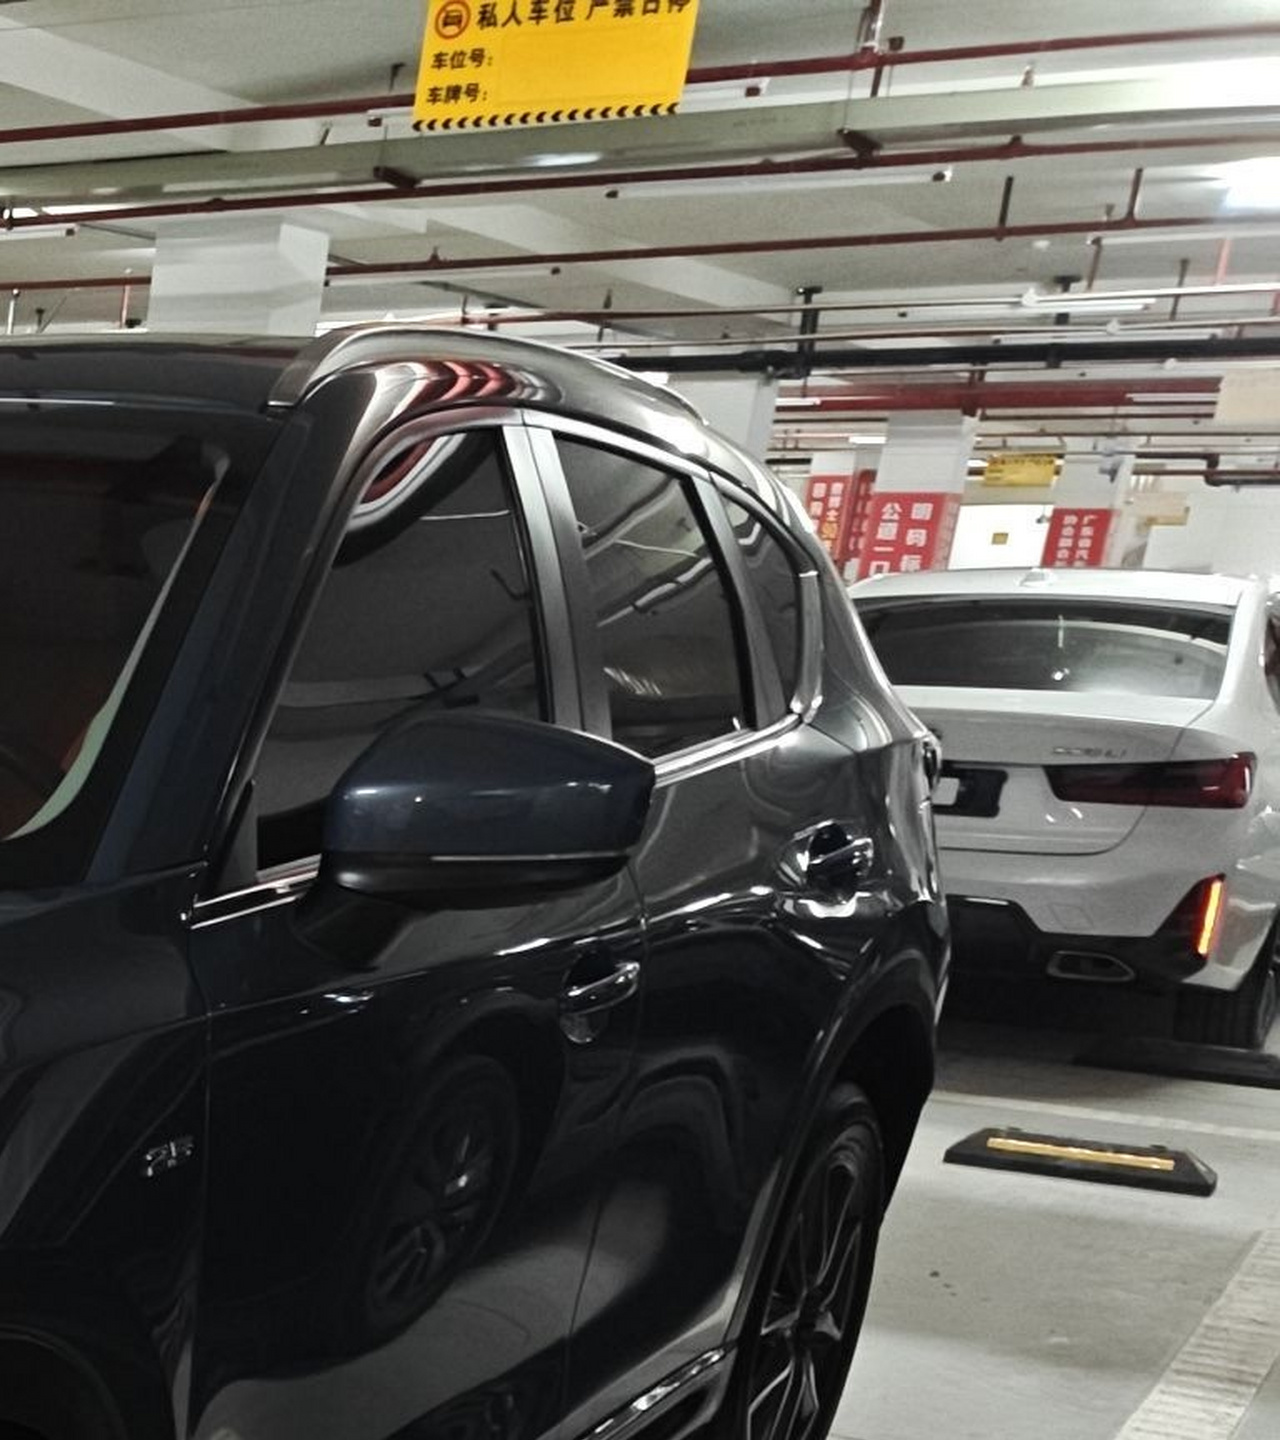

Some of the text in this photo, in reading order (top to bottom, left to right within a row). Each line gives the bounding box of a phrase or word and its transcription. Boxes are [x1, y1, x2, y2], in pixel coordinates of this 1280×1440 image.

[476, 0, 575, 30] 私人车位
[430, 48, 492, 70] 车位号：
[426, 83, 488, 104] 车牌号：
